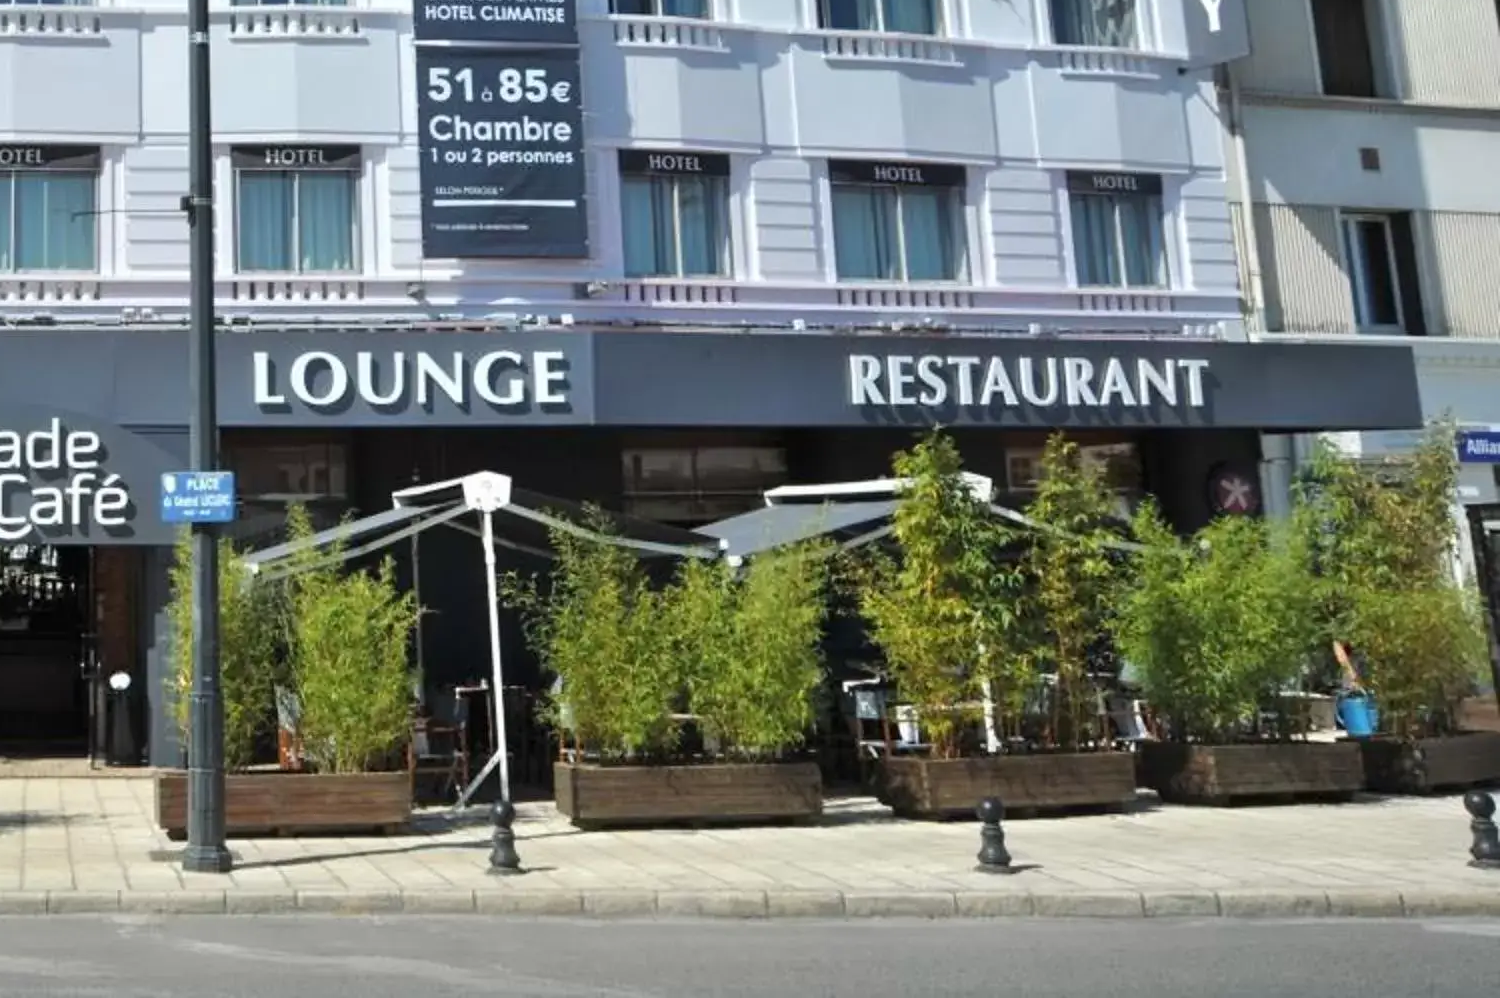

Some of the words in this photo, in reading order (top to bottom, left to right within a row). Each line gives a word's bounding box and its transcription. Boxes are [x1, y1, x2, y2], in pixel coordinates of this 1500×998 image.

[425, 5, 477, 21] HOTEL
[480, 6, 565, 23] CLIMATISE
[428, 67, 474, 102] 51
[429, 114, 572, 142] Chambre
[265, 149, 328, 164] HOTEL
[431, 147, 439, 163] 1
[445, 151, 467, 163] ou
[471, 148, 483, 163] 2
[487, 151, 574, 167] personnes
[648, 153, 702, 173] HOTEL
[874, 166, 925, 184] HOTEL
[1094, 176, 1139, 192] HOTEL
[253, 351, 566, 405] LOUNGE
[849, 354, 1210, 407] RESTAURANT
